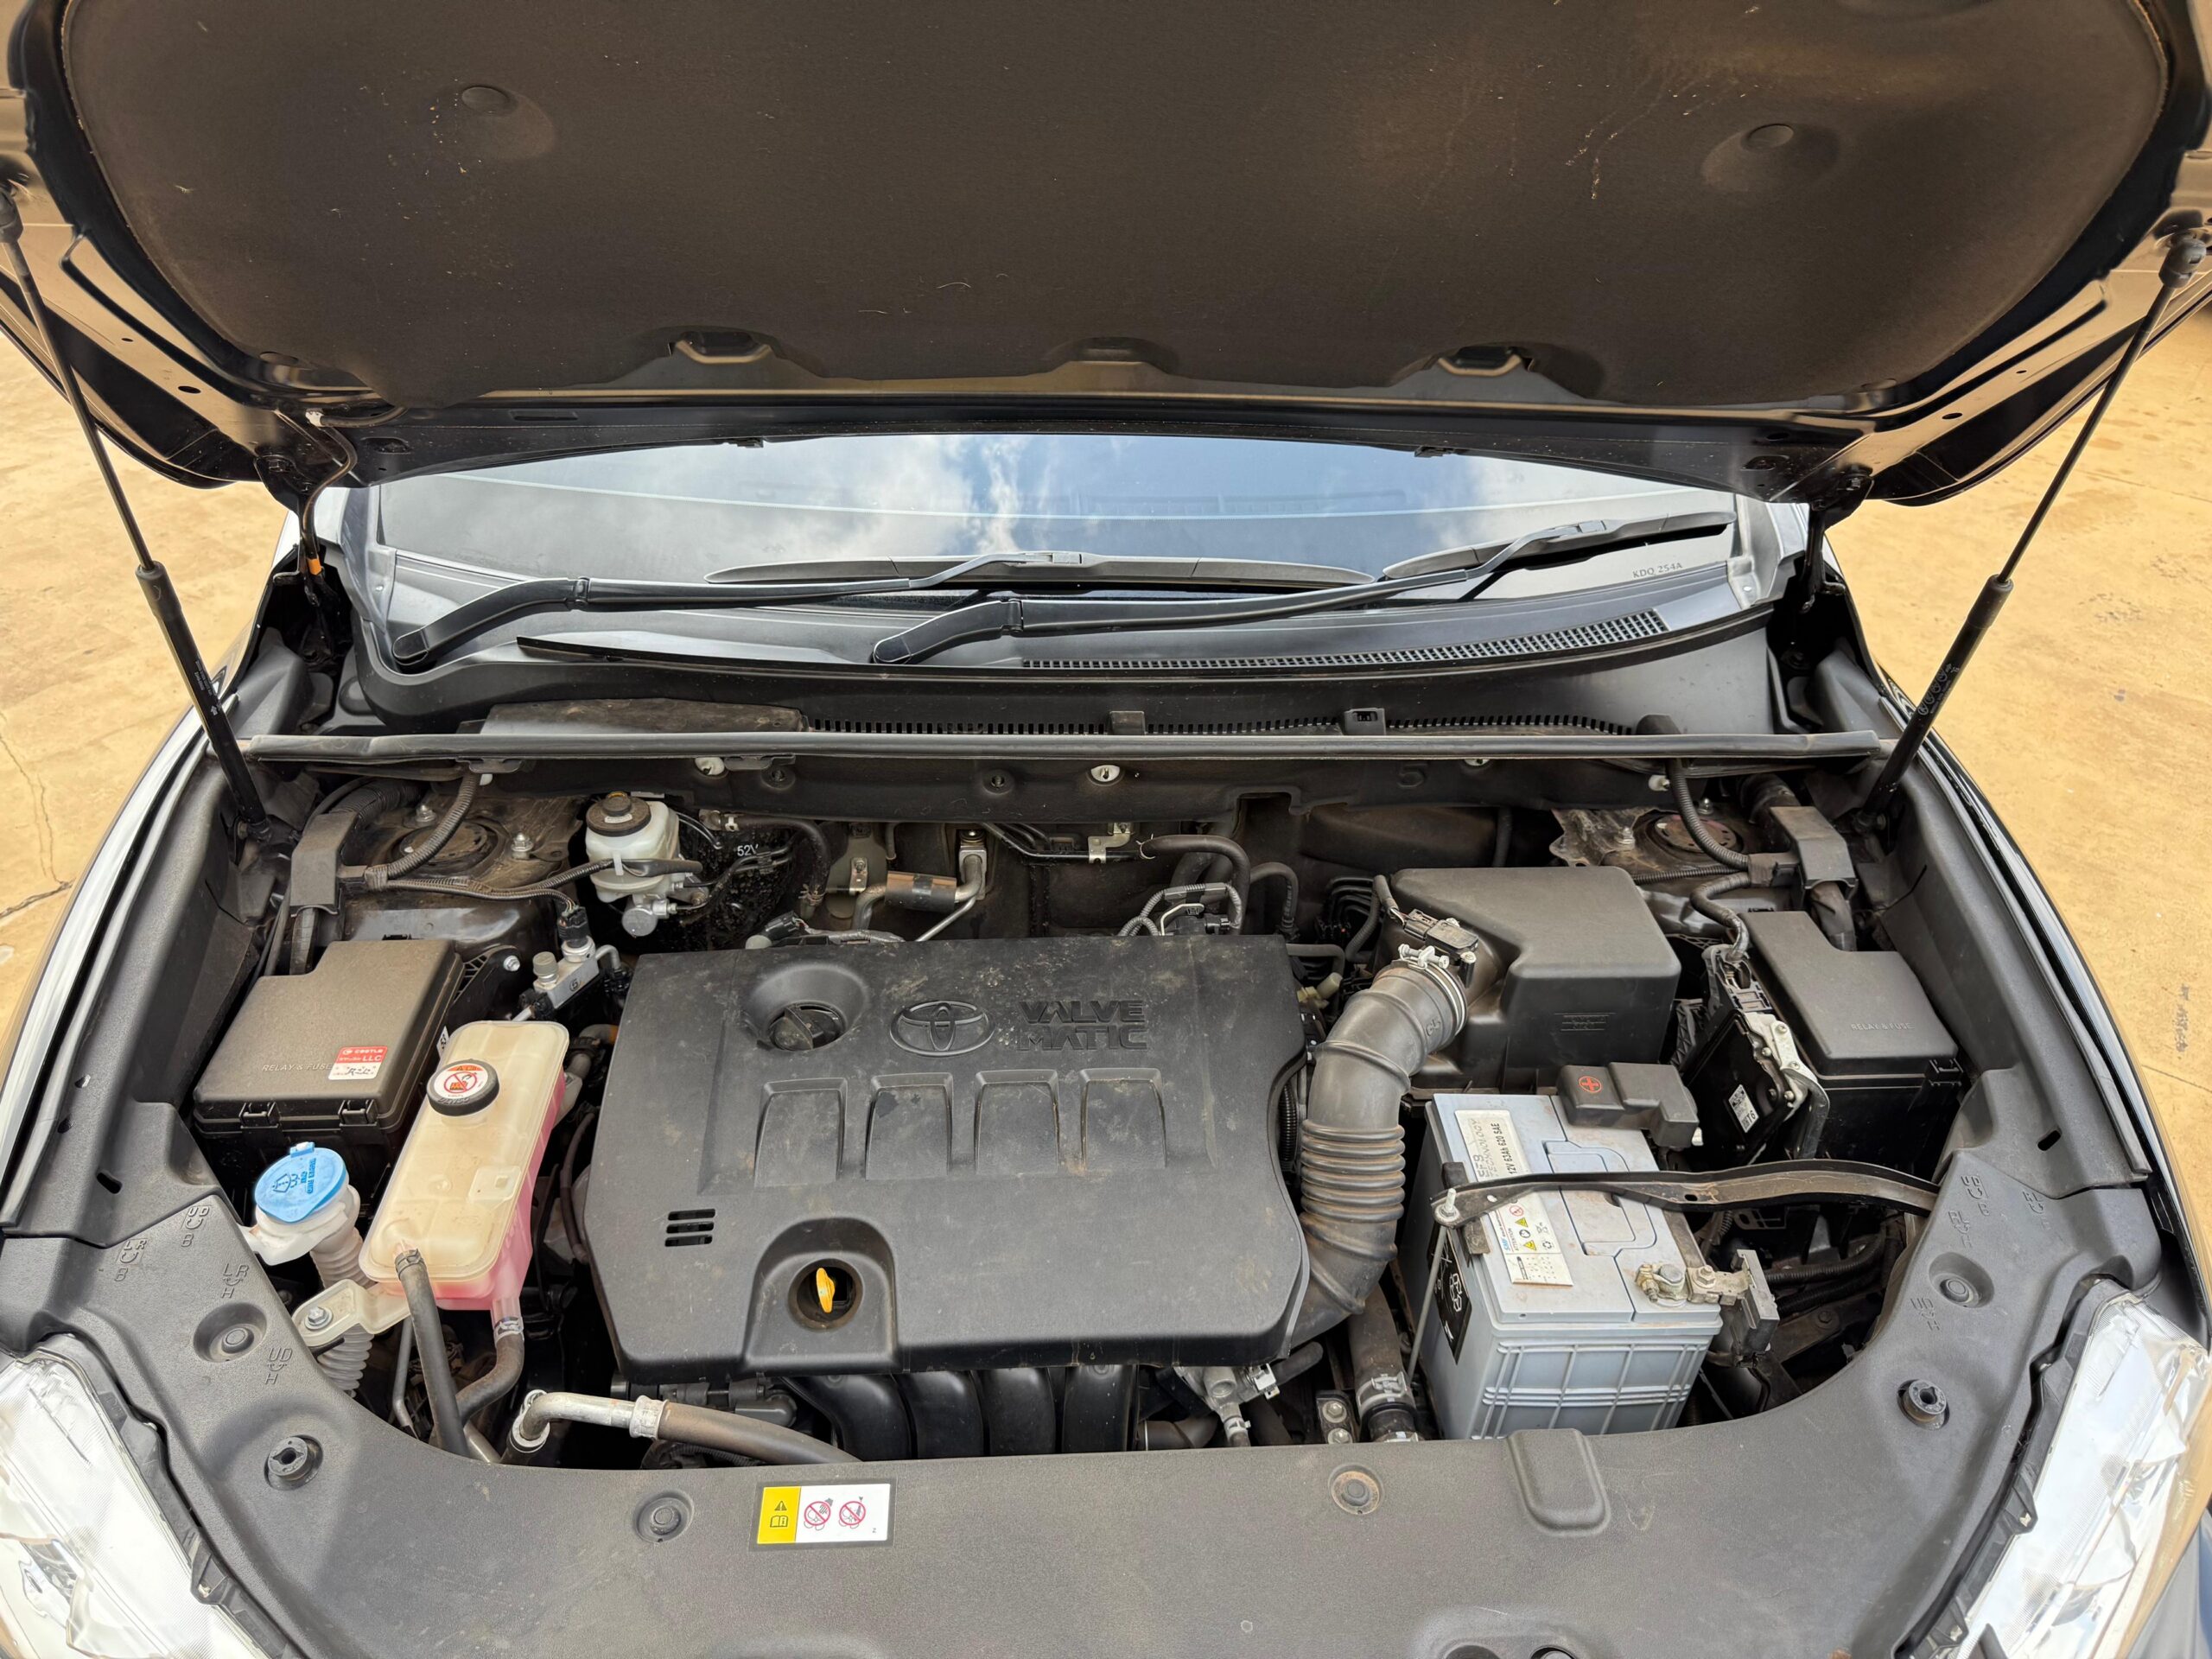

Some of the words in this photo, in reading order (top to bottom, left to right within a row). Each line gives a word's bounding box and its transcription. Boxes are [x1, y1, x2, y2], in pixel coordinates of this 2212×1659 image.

[1632, 567, 1655, 578] KDQ
[1657, 563, 1682, 573] 254A
[1018, 999, 1147, 1024] VALVE
[1851, 1022, 1878, 1031] RELAY
[1018, 1025, 1148, 1051] MATIC
[261, 1064, 297, 1072] RELAY
[1491, 1122, 1503, 1135] SAE
[1495, 1135, 1507, 1147] 620
[1505, 1162, 1518, 1174] 12V
[188, 1205, 210, 1217] UD
[123, 1238, 148, 1250] LR
[181, 1233, 194, 1247] B
[114, 1268, 129, 1281] B
[222, 1262, 250, 1278] LR
[220, 1287, 235, 1299] H
[268, 1347, 293, 1362] UD
[265, 1373, 279, 1385] H
